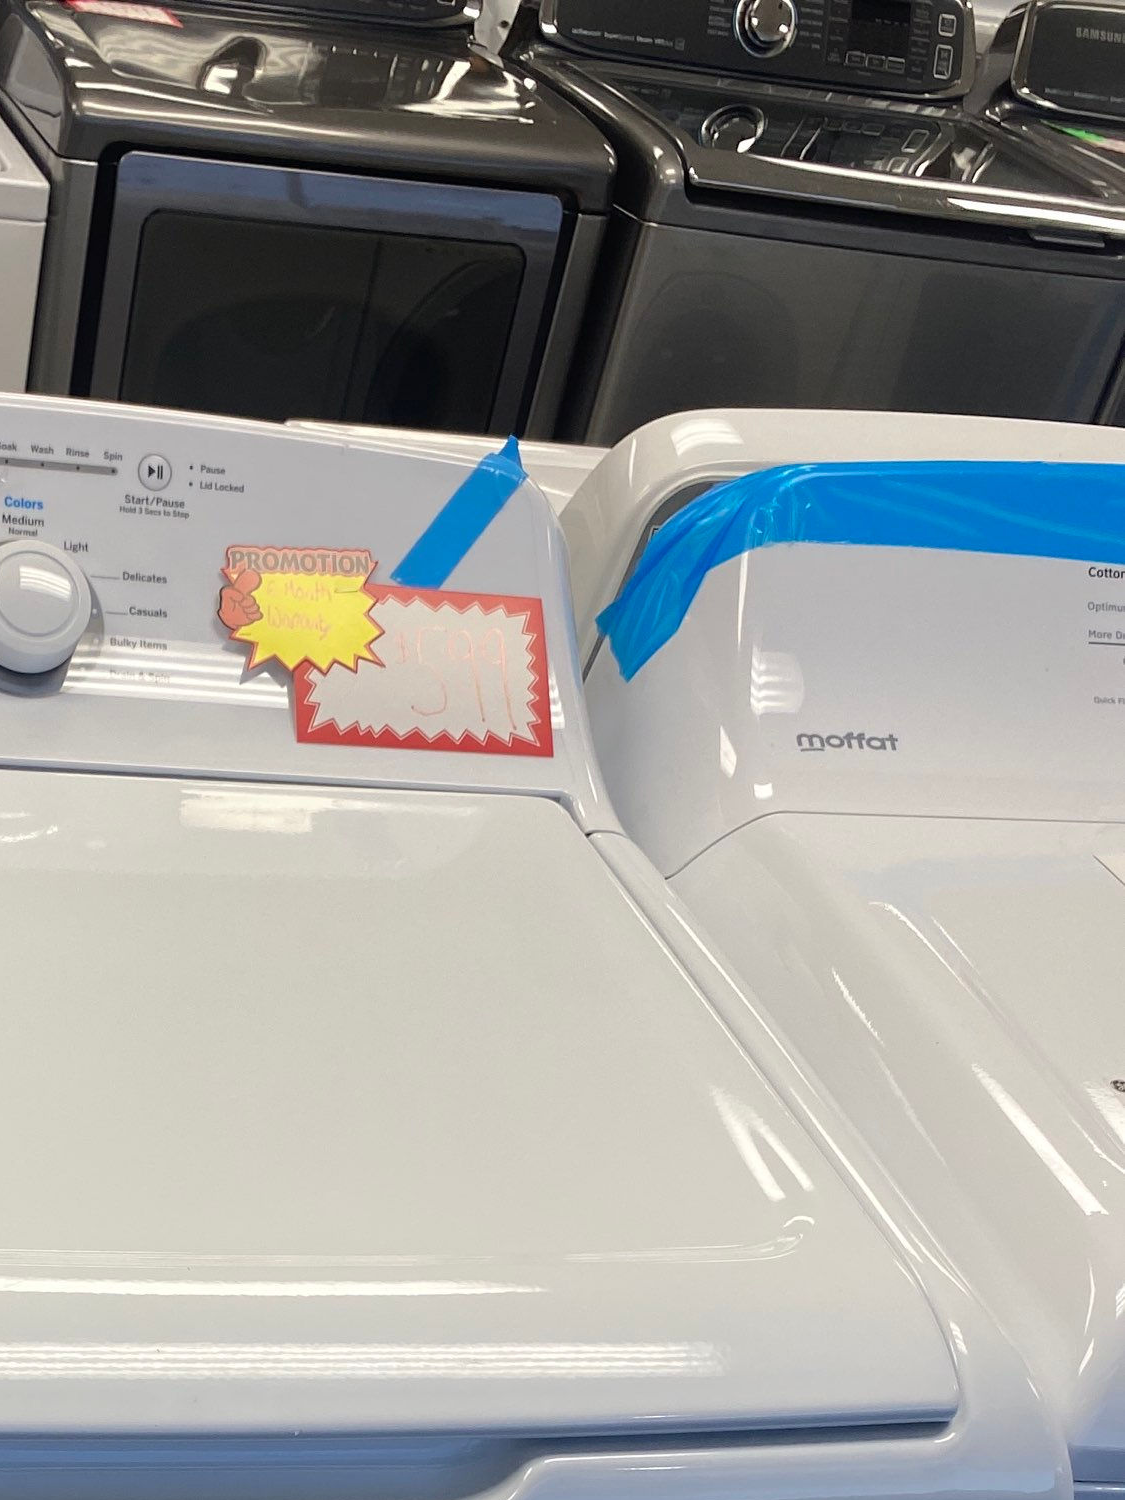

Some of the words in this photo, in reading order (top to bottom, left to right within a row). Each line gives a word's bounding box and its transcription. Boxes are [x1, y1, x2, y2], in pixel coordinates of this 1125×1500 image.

[30, 444, 54, 455] Wash
[65, 447, 89, 459] Rinse
[103, 451, 123, 463] Spin
[200, 465, 226, 476] Pause
[200, 480, 213, 491] Lid
[214, 482, 245, 493] Locked
[4, 496, 44, 511] Colors
[124, 494, 186, 510] Start/Pause
[119, 505, 137, 514] Hold
[137, 507, 143, 515] 3
[144, 507, 161, 516] Secs
[163, 509, 171, 517] to
[172, 510, 190, 520] Stop
[2, 514, 45, 528] Medium
[8, 526, 38, 537] Normal
[63, 541, 89, 553] Light
[230, 550, 370, 575] PROMOTION
[122, 571, 168, 584] Delicates
[129, 606, 168, 619] Casuals
[1088, 629, 1112, 640] More
[110, 637, 137, 650] Bulky
[139, 639, 168, 651] Items
[796, 731, 898, 751] moffat
